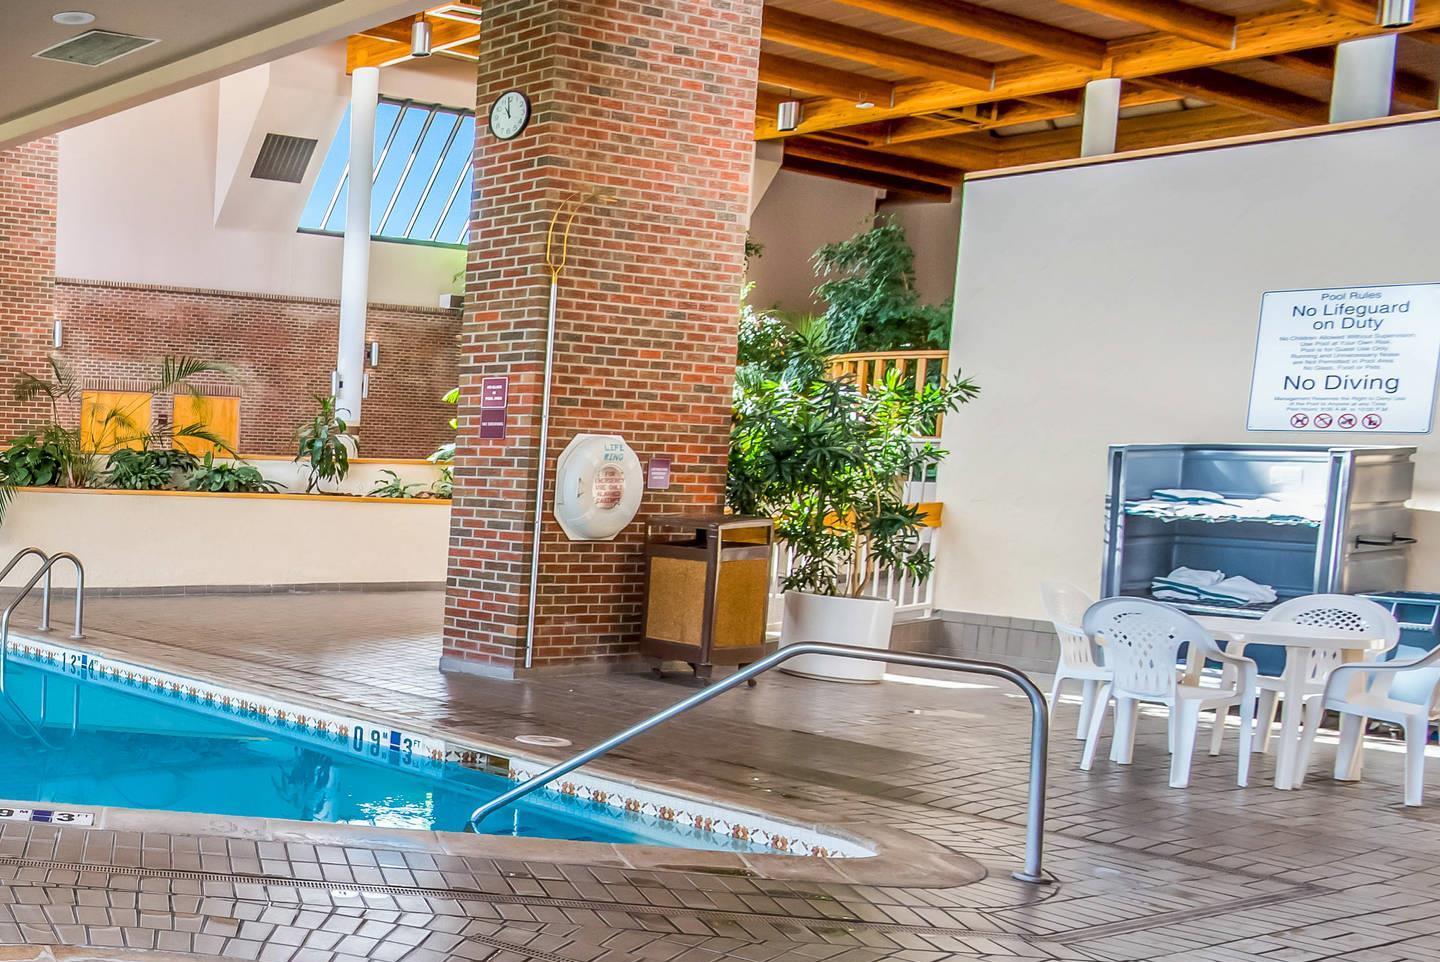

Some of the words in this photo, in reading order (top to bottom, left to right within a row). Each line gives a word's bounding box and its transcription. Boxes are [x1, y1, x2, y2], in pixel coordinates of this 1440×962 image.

[1292, 305, 1316, 317] No
[1324, 301, 1410, 317] Lifeguard
[1313, 320, 1334, 330] on
[1342, 318, 1384, 331] Duty
[1284, 376, 1315, 390] No
[1325, 375, 1400, 394] Diving
